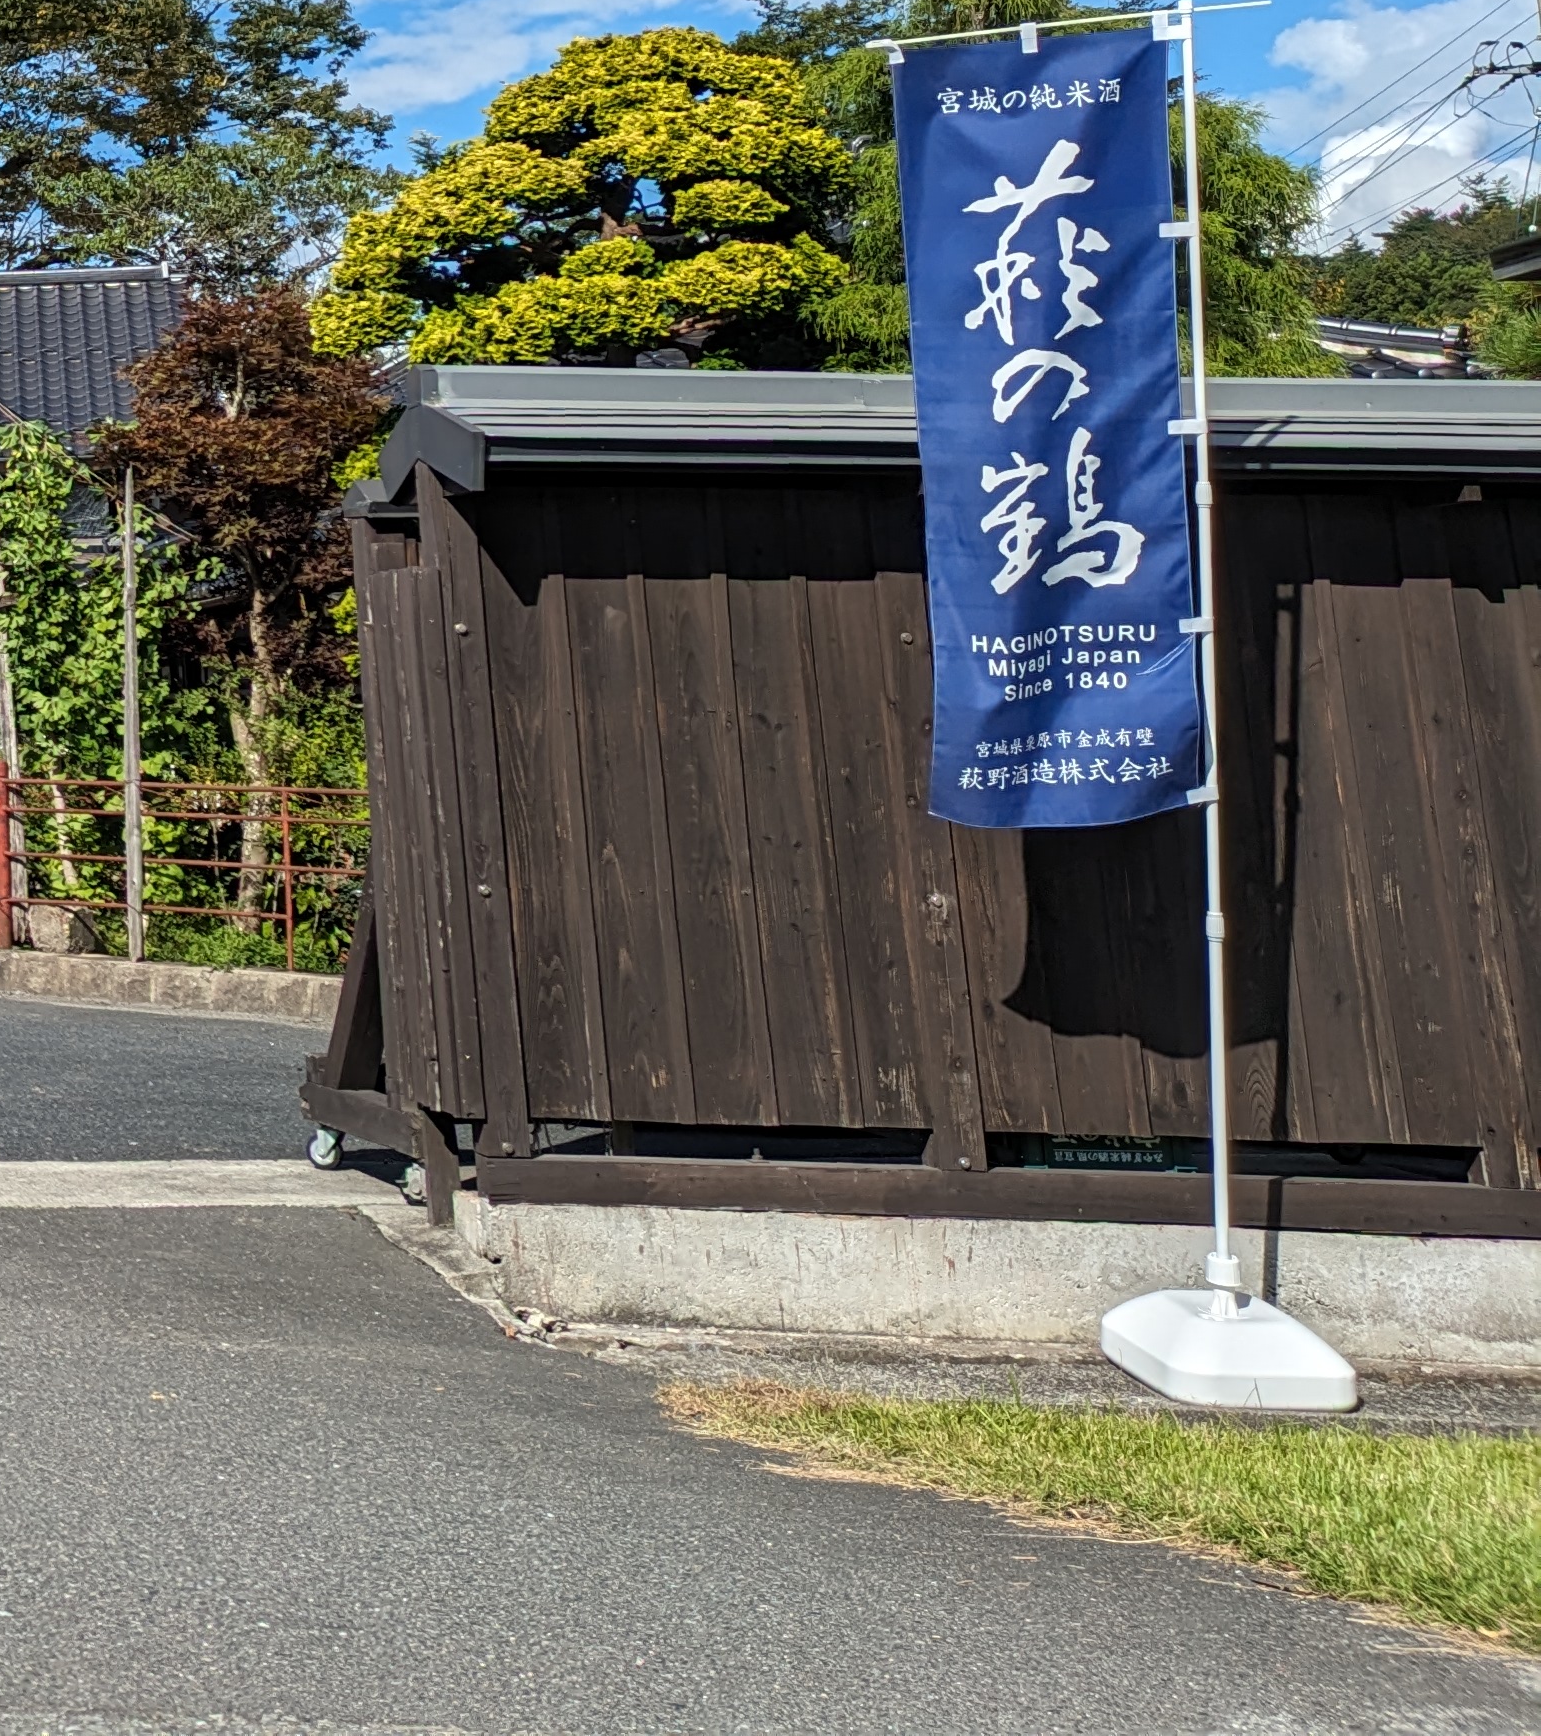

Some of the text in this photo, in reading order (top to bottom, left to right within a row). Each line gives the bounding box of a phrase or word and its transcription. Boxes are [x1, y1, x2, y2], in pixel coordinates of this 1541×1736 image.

[936, 77, 1122, 115] 宮城の純米酒
[962, 138, 1146, 595] 萩の鶴
[971, 624, 1156, 654] HAGINOTSURU
[988, 647, 1141, 679] Miyagi Japan
[1004, 671, 1127, 701] Since 1840
[957, 756, 1174, 791] 萩野酒造株式会社
